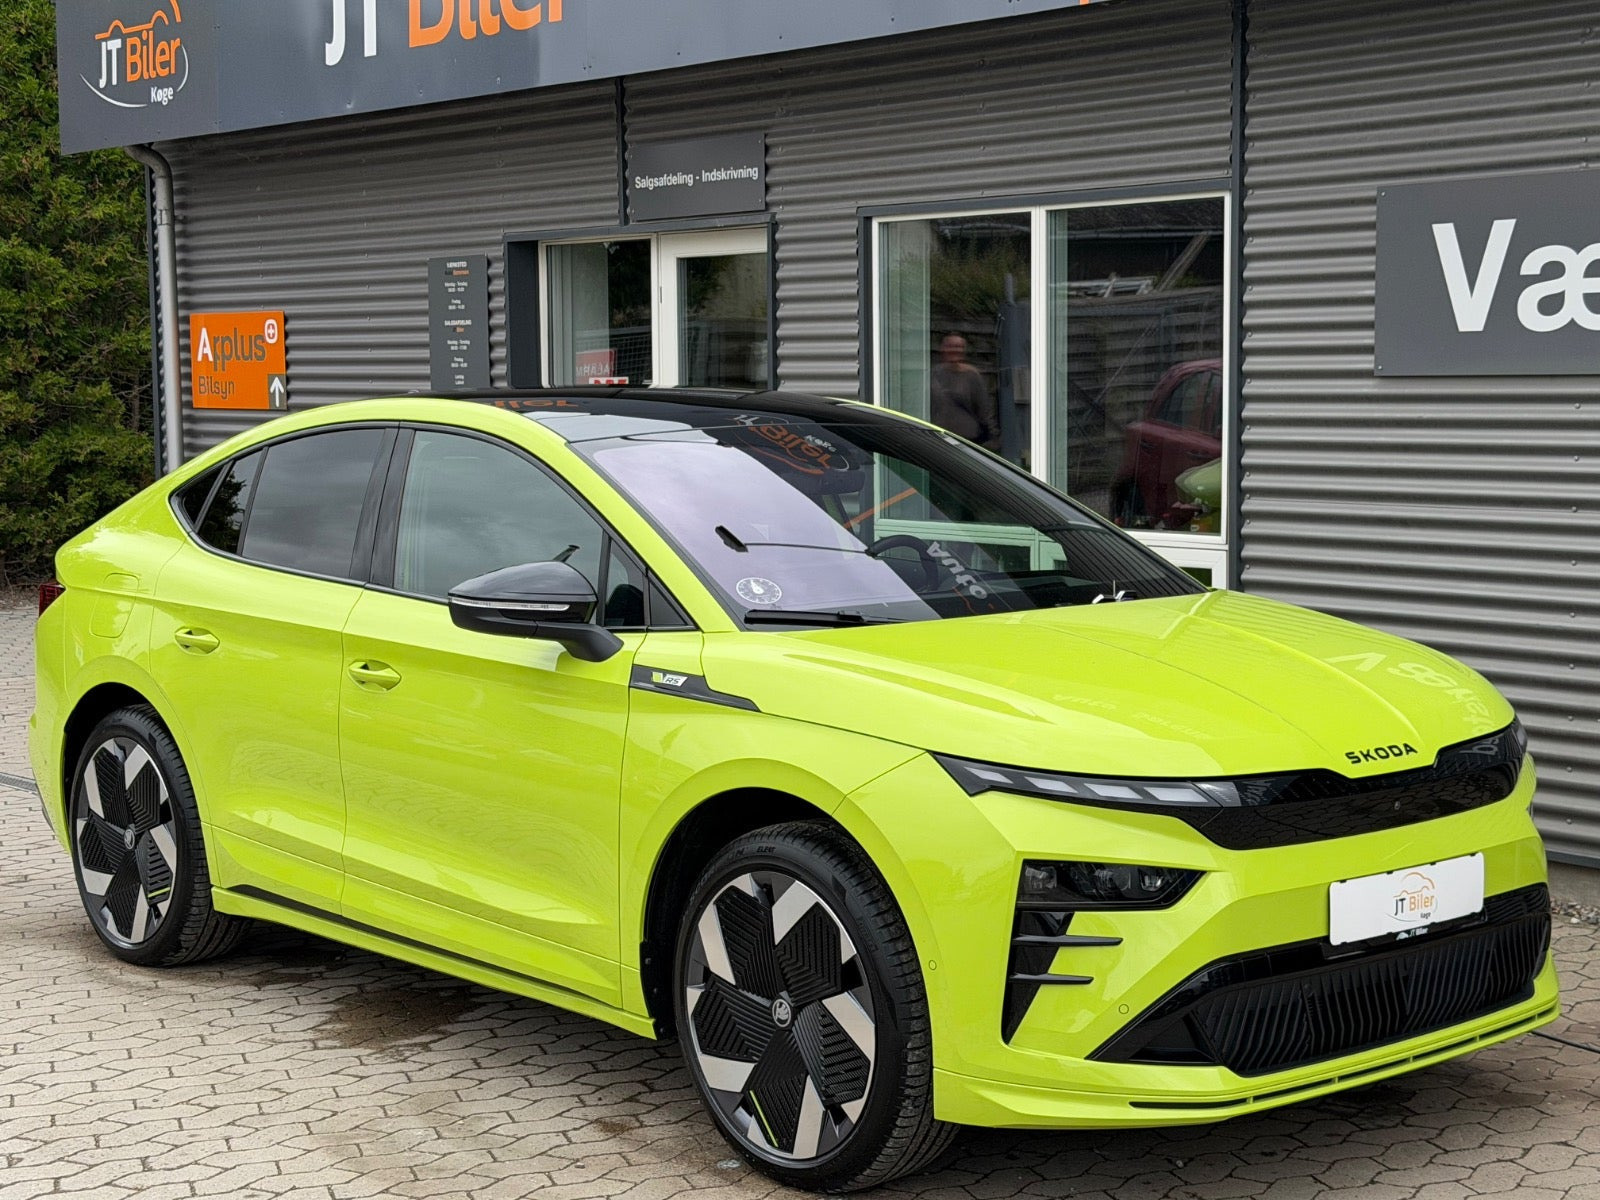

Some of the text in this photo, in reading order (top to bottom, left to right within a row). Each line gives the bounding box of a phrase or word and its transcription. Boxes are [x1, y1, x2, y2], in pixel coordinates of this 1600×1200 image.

[99, 30, 181, 89] JT Biler
[150, 86, 174, 105] Køge
[635, 171, 694, 190] Salgsafdeling
[702, 165, 759, 182] Indskrivning
[198, 375, 235, 400] Bilsyn
[1394, 894, 1434, 916] JT Biler
